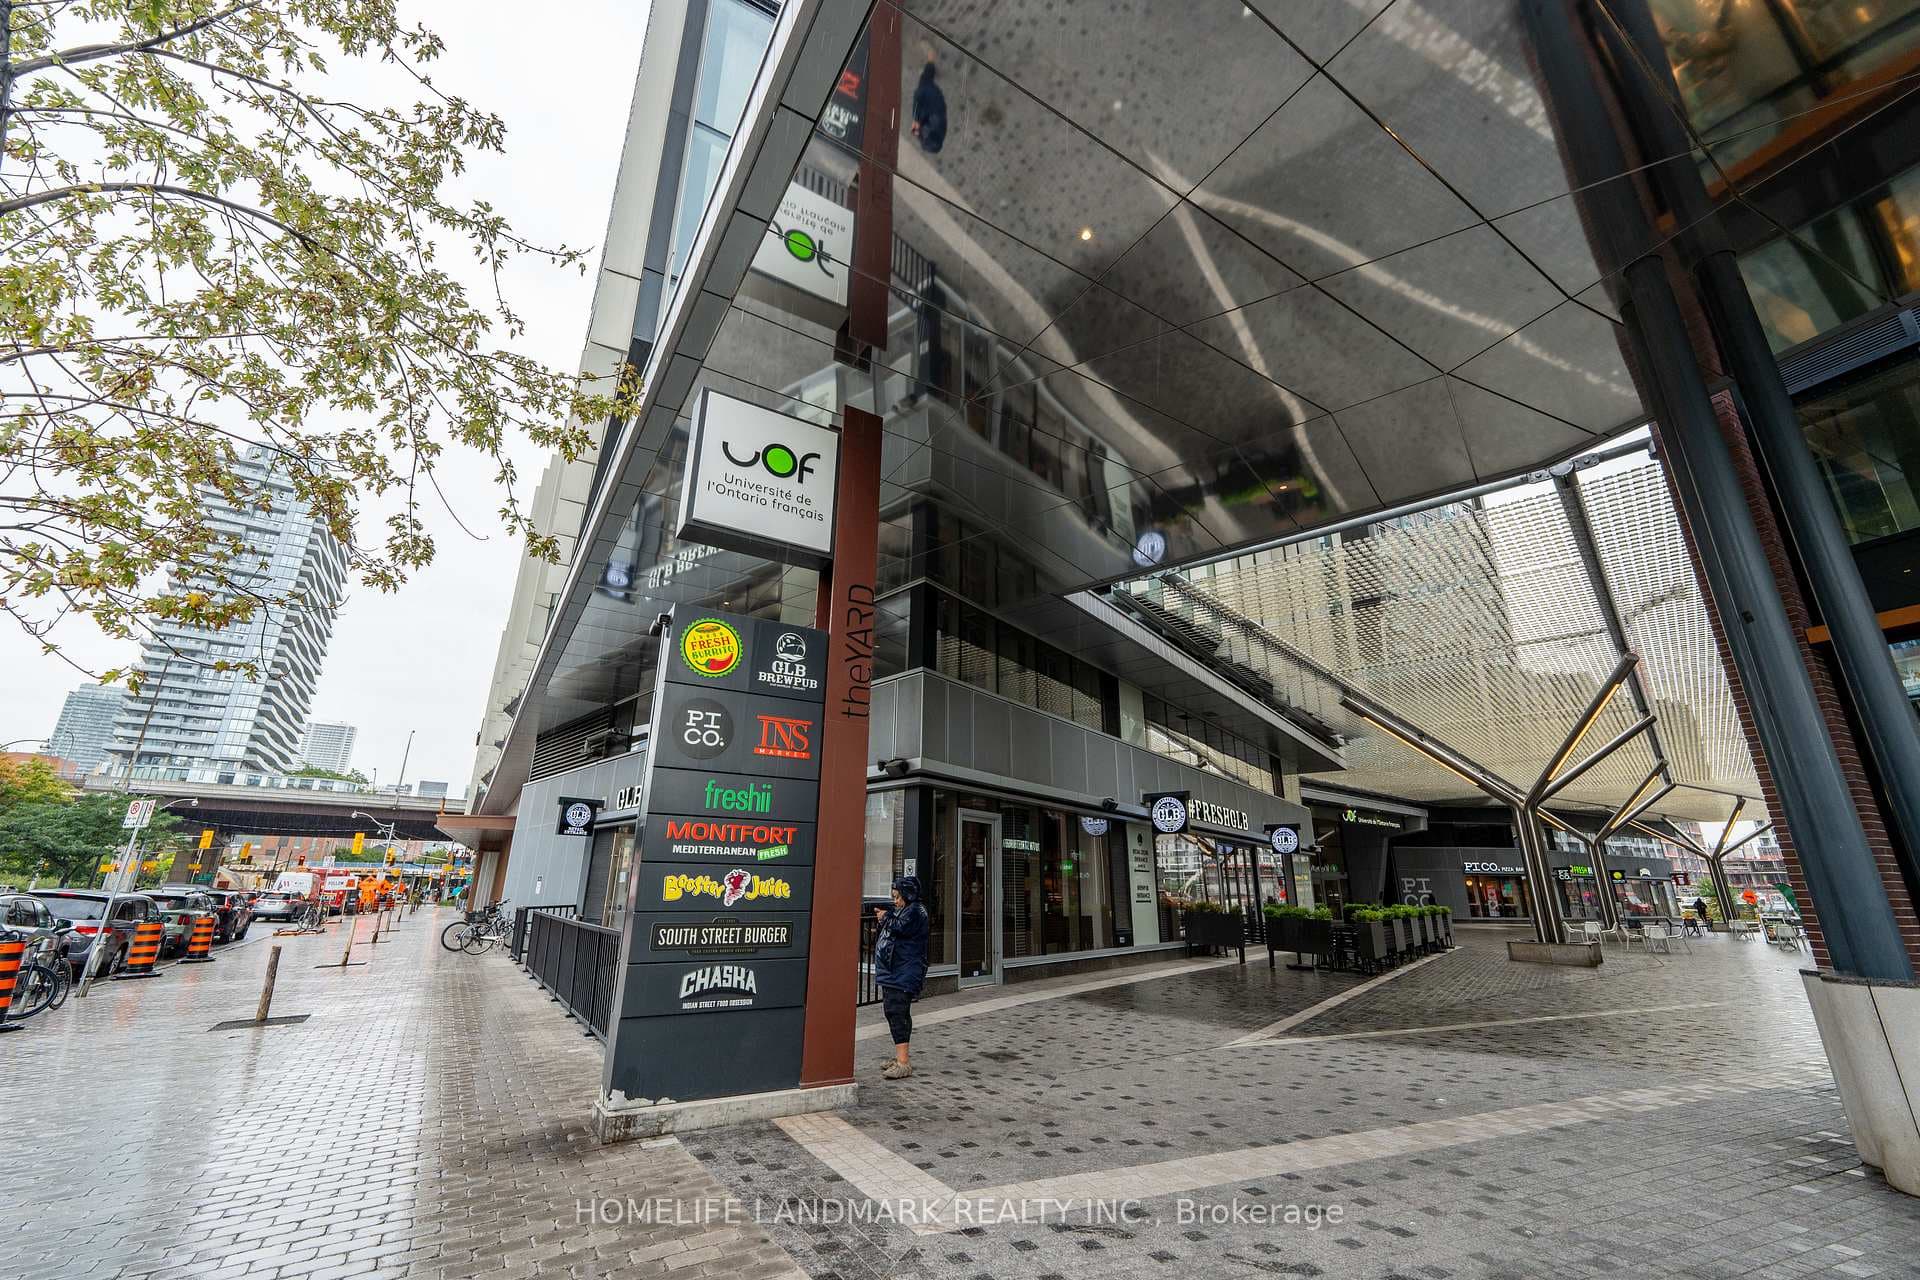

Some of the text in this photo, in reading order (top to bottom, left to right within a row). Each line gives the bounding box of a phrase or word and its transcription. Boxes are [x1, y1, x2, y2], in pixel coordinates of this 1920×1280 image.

[724, 472, 812, 506] Université de
[707, 480, 824, 522] l'Ontario français
[691, 636, 731, 650] FRESH
[841, 584, 875, 719] theYARD
[691, 646, 734, 659] BURRITO
[771, 660, 807, 677] GLB
[758, 671, 818, 689] BREWPUB
[686, 709, 722, 730] PI
[759, 720, 809, 751] INS
[759, 748, 806, 758] MARKET
[616, 785, 642, 811] GLB
[704, 779, 772, 813] freshii
[1157, 808, 1181, 821] GLB
[1188, 799, 1249, 831] #FRESHGLB
[666, 820, 799, 844] MONTFORT
[1276, 835, 1294, 844] GLB
[672, 844, 788, 859] MEDITERRANEAN FRESH
[1464, 862, 1480, 872] PI
[1481, 862, 1500, 872] CO.
[663, 874, 791, 902] Booster Juice
[1401, 878, 1432, 893] PI
[658, 927, 787, 945] SOUTH STREET BURGER
[680, 965, 757, 999] CHASKA
[698, 1000, 716, 1008] STREET
